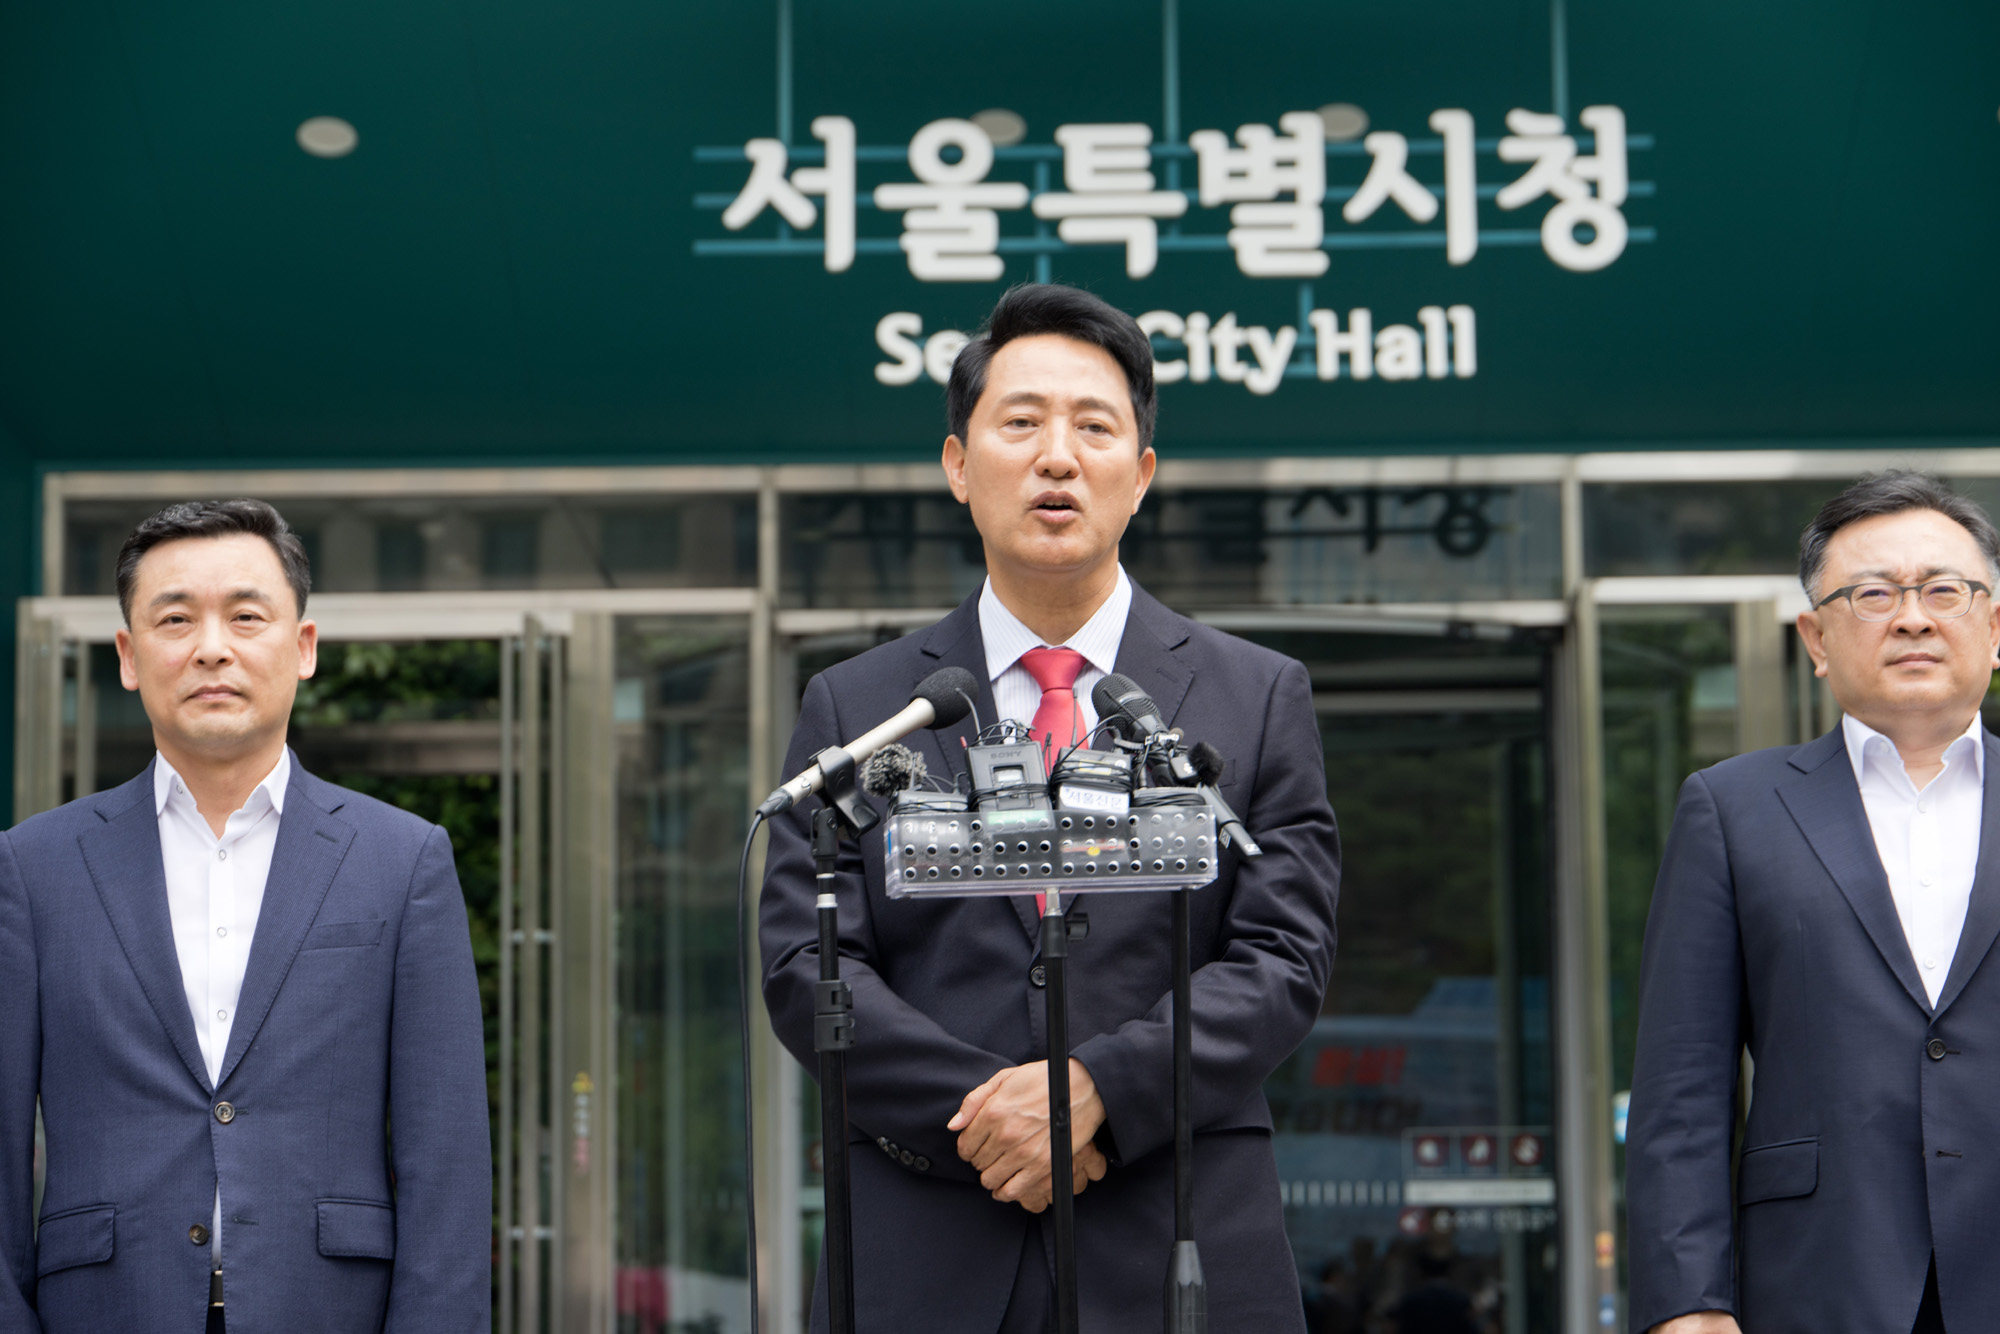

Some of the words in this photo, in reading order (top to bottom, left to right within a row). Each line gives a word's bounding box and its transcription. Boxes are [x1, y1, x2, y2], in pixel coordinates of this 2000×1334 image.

[723, 106, 1628, 281] 서울특별시청
[1136, 310, 1298, 395] City
[1309, 305, 1477, 381] Hall
